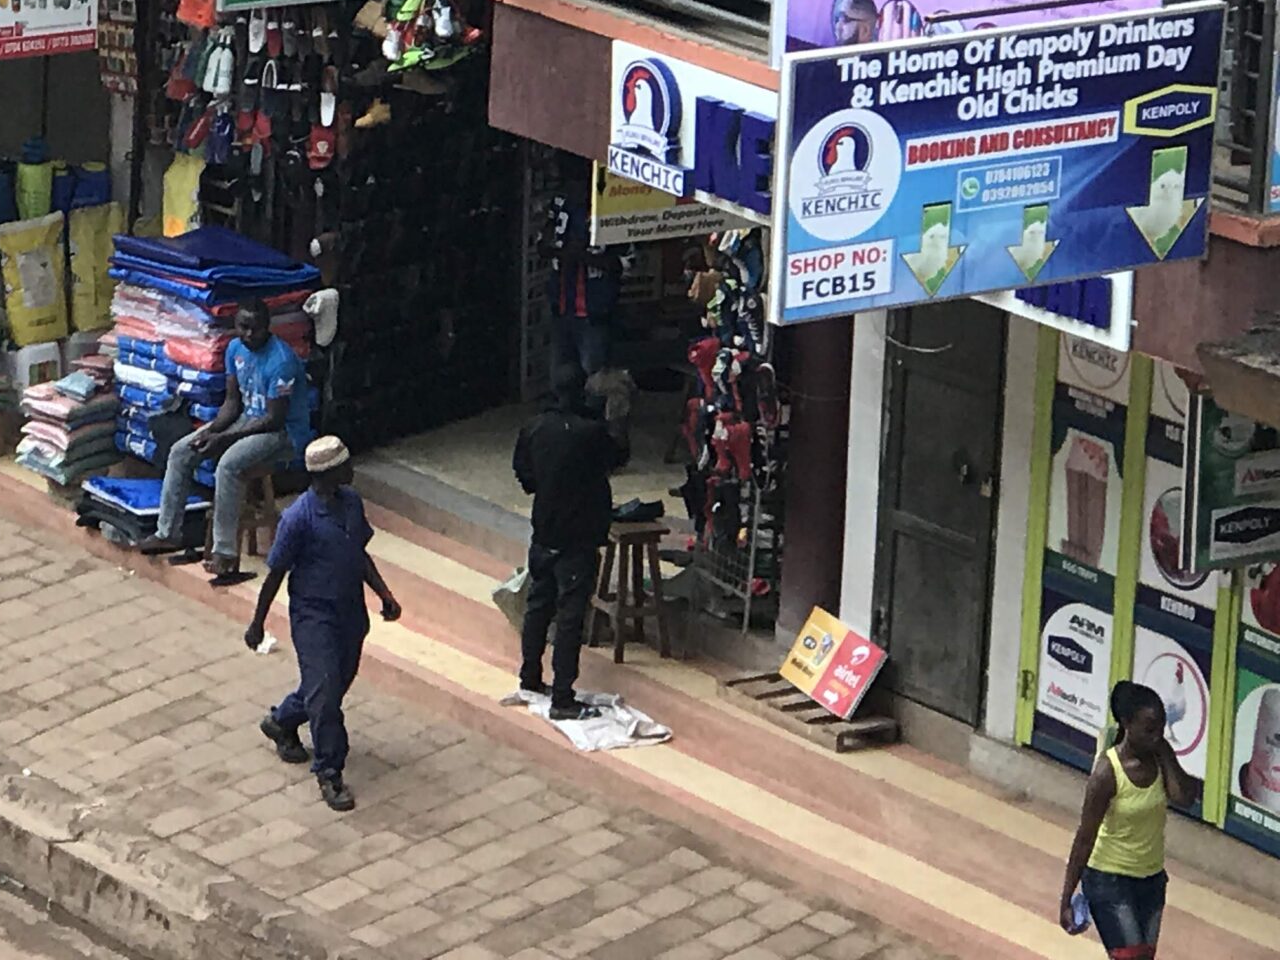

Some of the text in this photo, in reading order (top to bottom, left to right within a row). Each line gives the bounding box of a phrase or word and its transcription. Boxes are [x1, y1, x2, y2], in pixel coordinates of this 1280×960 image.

[836, 17, 1195, 82] The Home Of Kenpoly Drinkers
[850, 44, 1192, 109] & Kenchic High Premium Day
[957, 83, 1079, 121] Old Chicks
[1142, 101, 1200, 120] KENPOLY
[907, 116, 1118, 165] BOOKING AND CONSULTANCY
[609, 149, 683, 195] KENCHIC
[801, 192, 882, 216] KENCHIC
[790, 246, 887, 276] SHOP NO:
[801, 270, 877, 301] FCB15
[1050, 641, 1087, 666] KENPOLY
